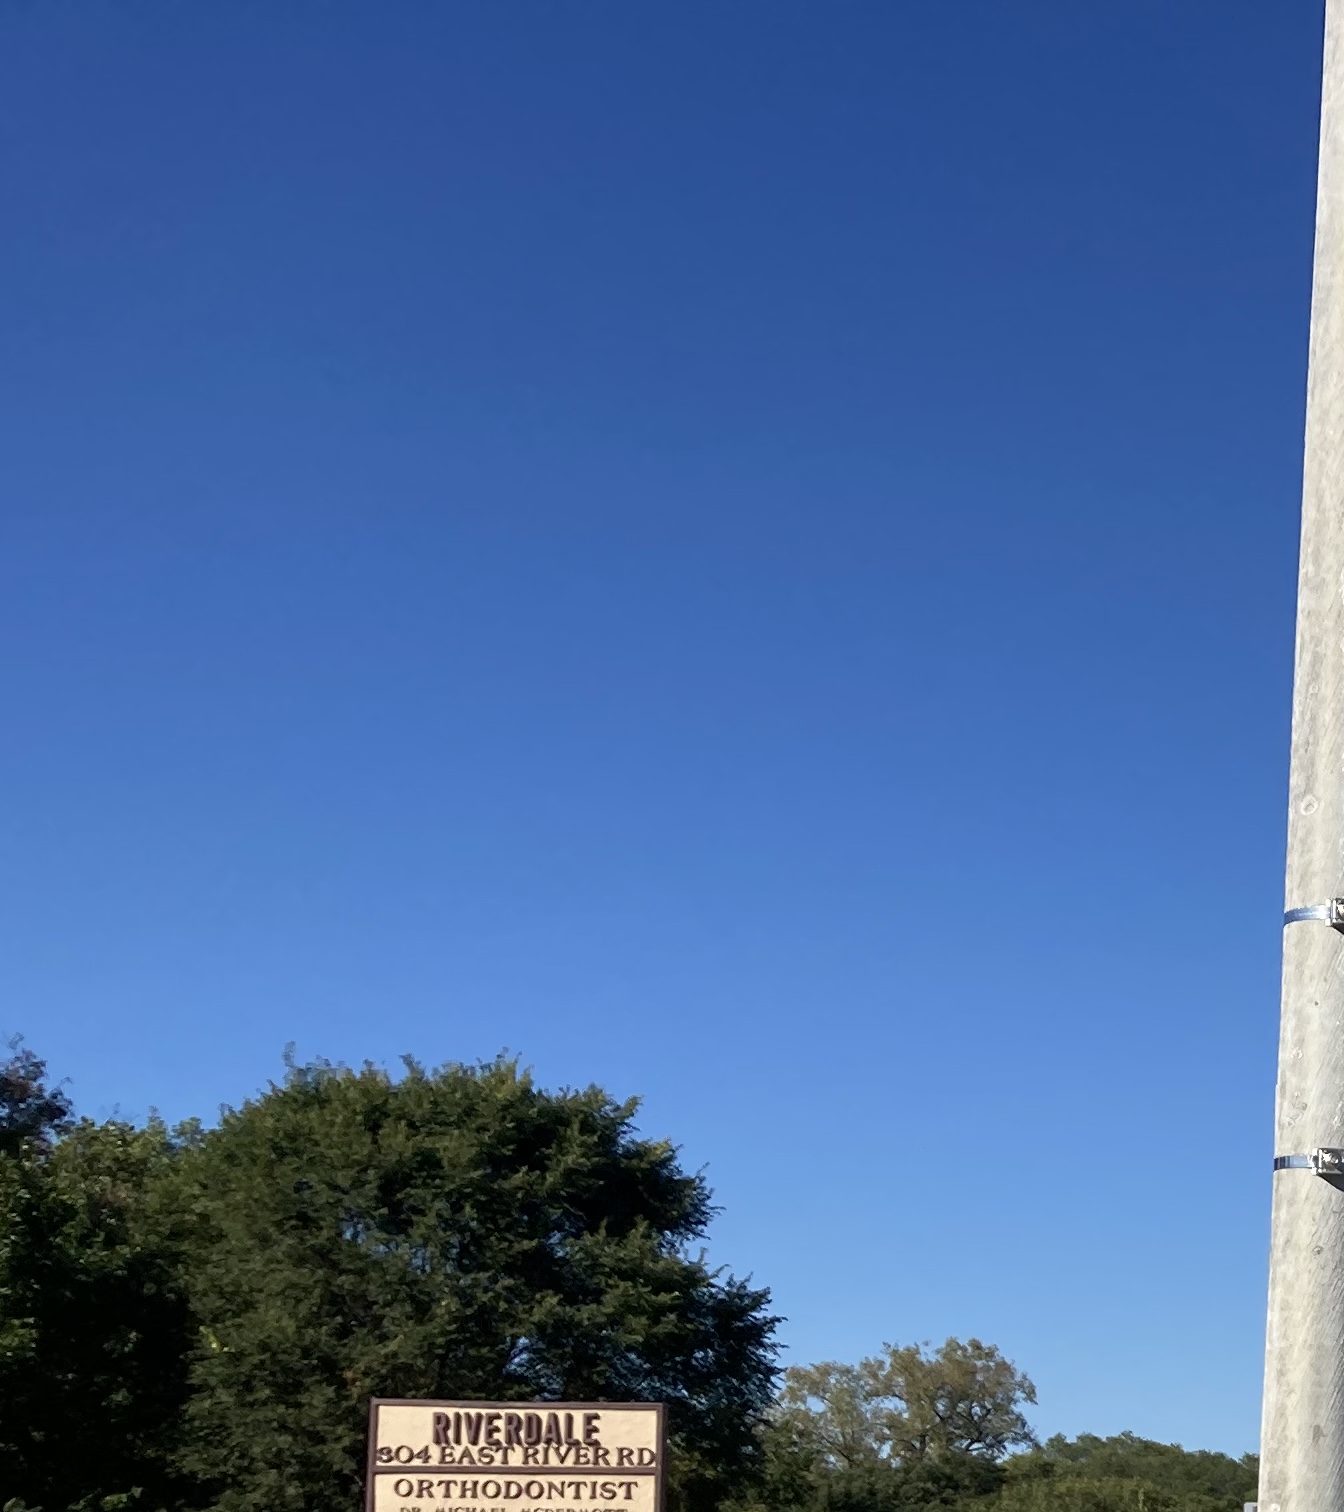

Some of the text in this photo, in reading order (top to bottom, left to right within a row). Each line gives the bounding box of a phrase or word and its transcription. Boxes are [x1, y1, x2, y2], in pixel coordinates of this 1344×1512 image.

[432, 1411, 601, 1446] RIVERDALE
[438, 1445, 515, 1465] EAST
[521, 1446, 611, 1466] RIVER
[616, 1446, 656, 1466] RD
[394, 1478, 638, 1500] ORTHODONTIST
